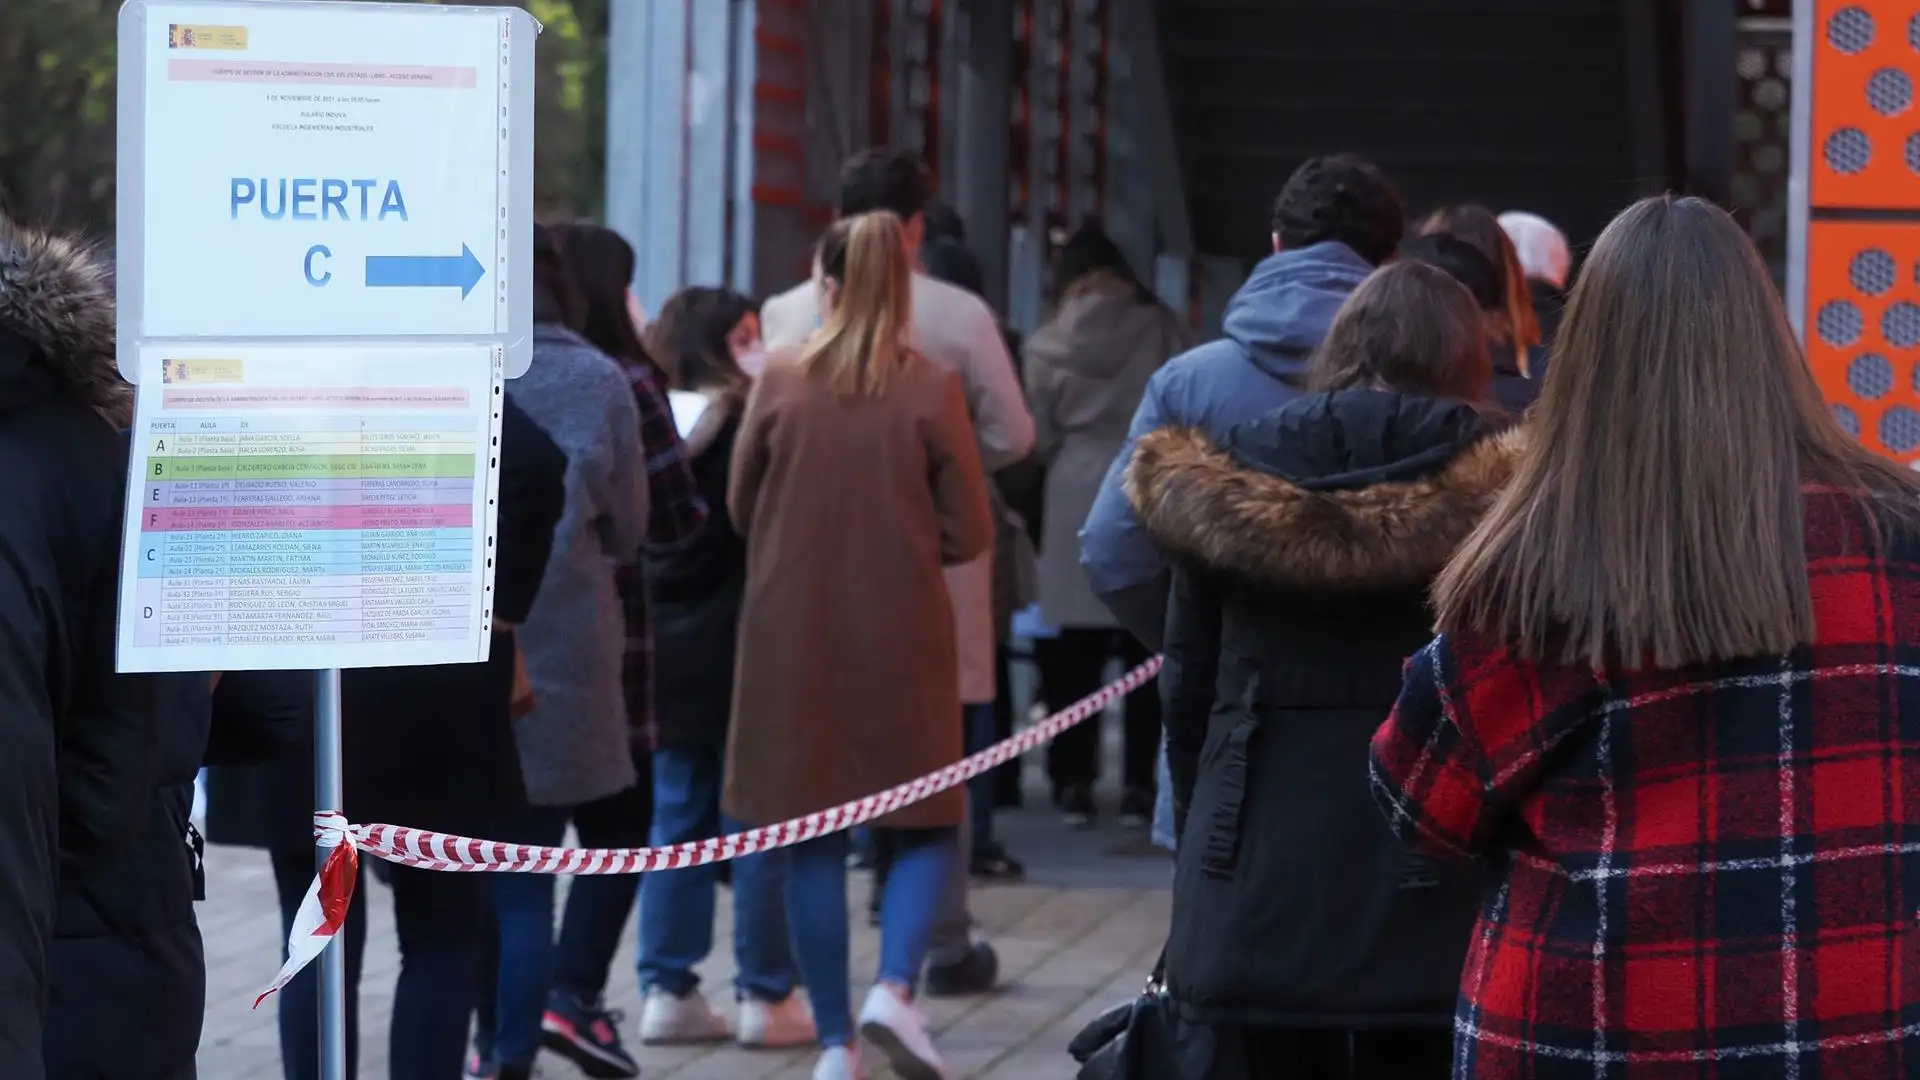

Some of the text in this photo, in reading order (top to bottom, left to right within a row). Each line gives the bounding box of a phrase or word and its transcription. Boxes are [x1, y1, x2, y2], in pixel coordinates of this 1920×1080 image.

[231, 177, 409, 221] PUERTA
[304, 244, 332, 287] C
[151, 422, 175, 430] PUERTA
[156, 439, 165, 452] A
[155, 463, 163, 475] B
[153, 489, 160, 500] E
[151, 514, 157, 526] F
[147, 548, 156, 561] C
[144, 606, 153, 619] D
